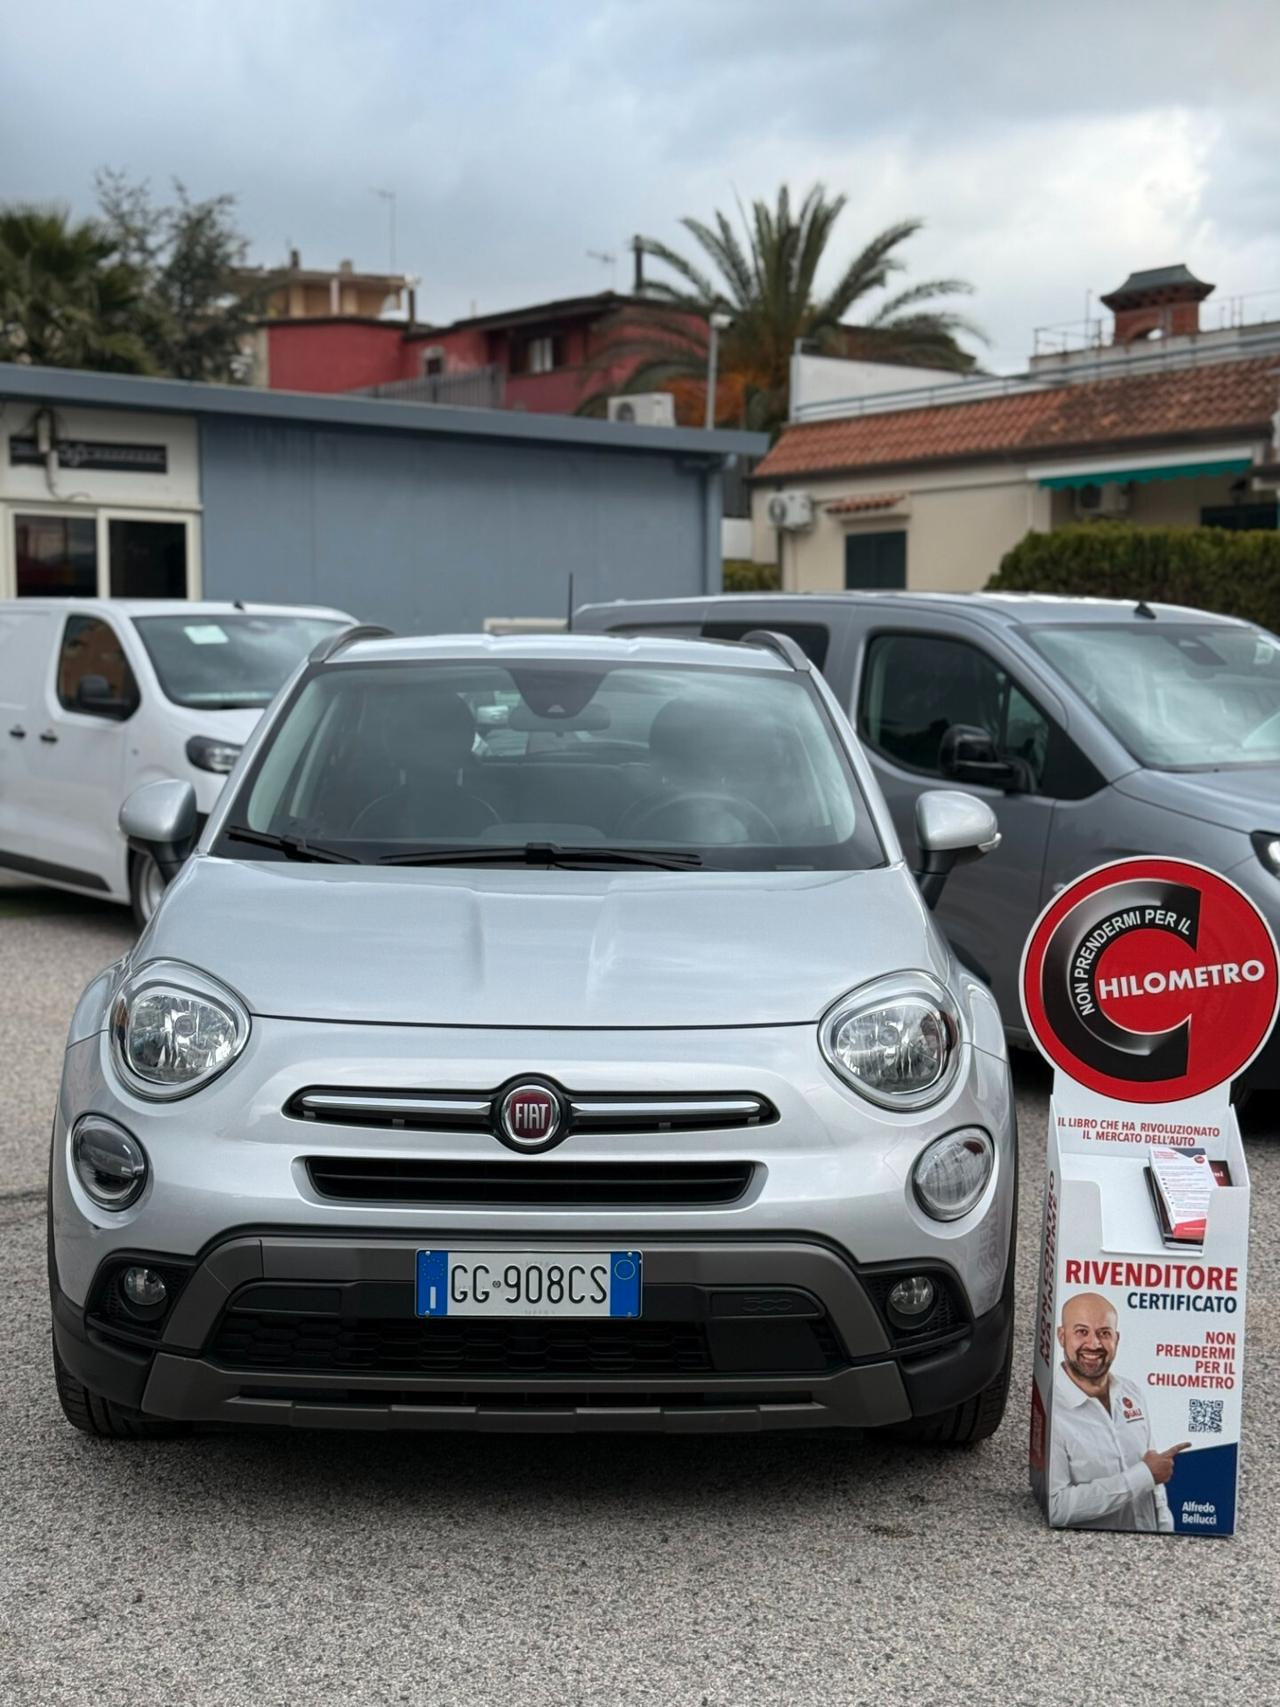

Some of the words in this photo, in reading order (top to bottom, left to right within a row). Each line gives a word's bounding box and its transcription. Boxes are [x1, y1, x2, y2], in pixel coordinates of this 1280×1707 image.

[1145, 909, 1177, 927] PER
[1177, 917, 1193, 935] IL
[1075, 911, 1140, 979] PRENDERMI
[1075, 983, 1096, 1016] NON
[515, 1103, 548, 1130] FIAT
[1057, 1117, 1067, 1128] IL
[1068, 1118, 1098, 1129] LIBRO
[1100, 1119, 1120, 1131] CHE
[1121, 1121, 1136, 1132] HA
[1140, 1123, 1220, 1137] RIVOLUZIONATO
[1082, 1130, 1092, 1140] IL
[1095, 1131, 1142, 1143] MERCATO
[1144, 1133, 1196, 1147] DELL'AUTO
[1065, 1259, 1239, 1291] RIVENDITORE
[1127, 1292, 1238, 1313] CERTIFICATO
[1205, 1331, 1236, 1345] NON
[1156, 1344, 1236, 1361] PRENDERMI
[1195, 1361, 1222, 1374] PER
[1223, 1362, 1236, 1375] IL
[1147, 1372, 1235, 1390] CHILOMETRO
[1182, 1501, 1216, 1513] Alfredo
[1182, 1513, 1217, 1525] Bellucci
